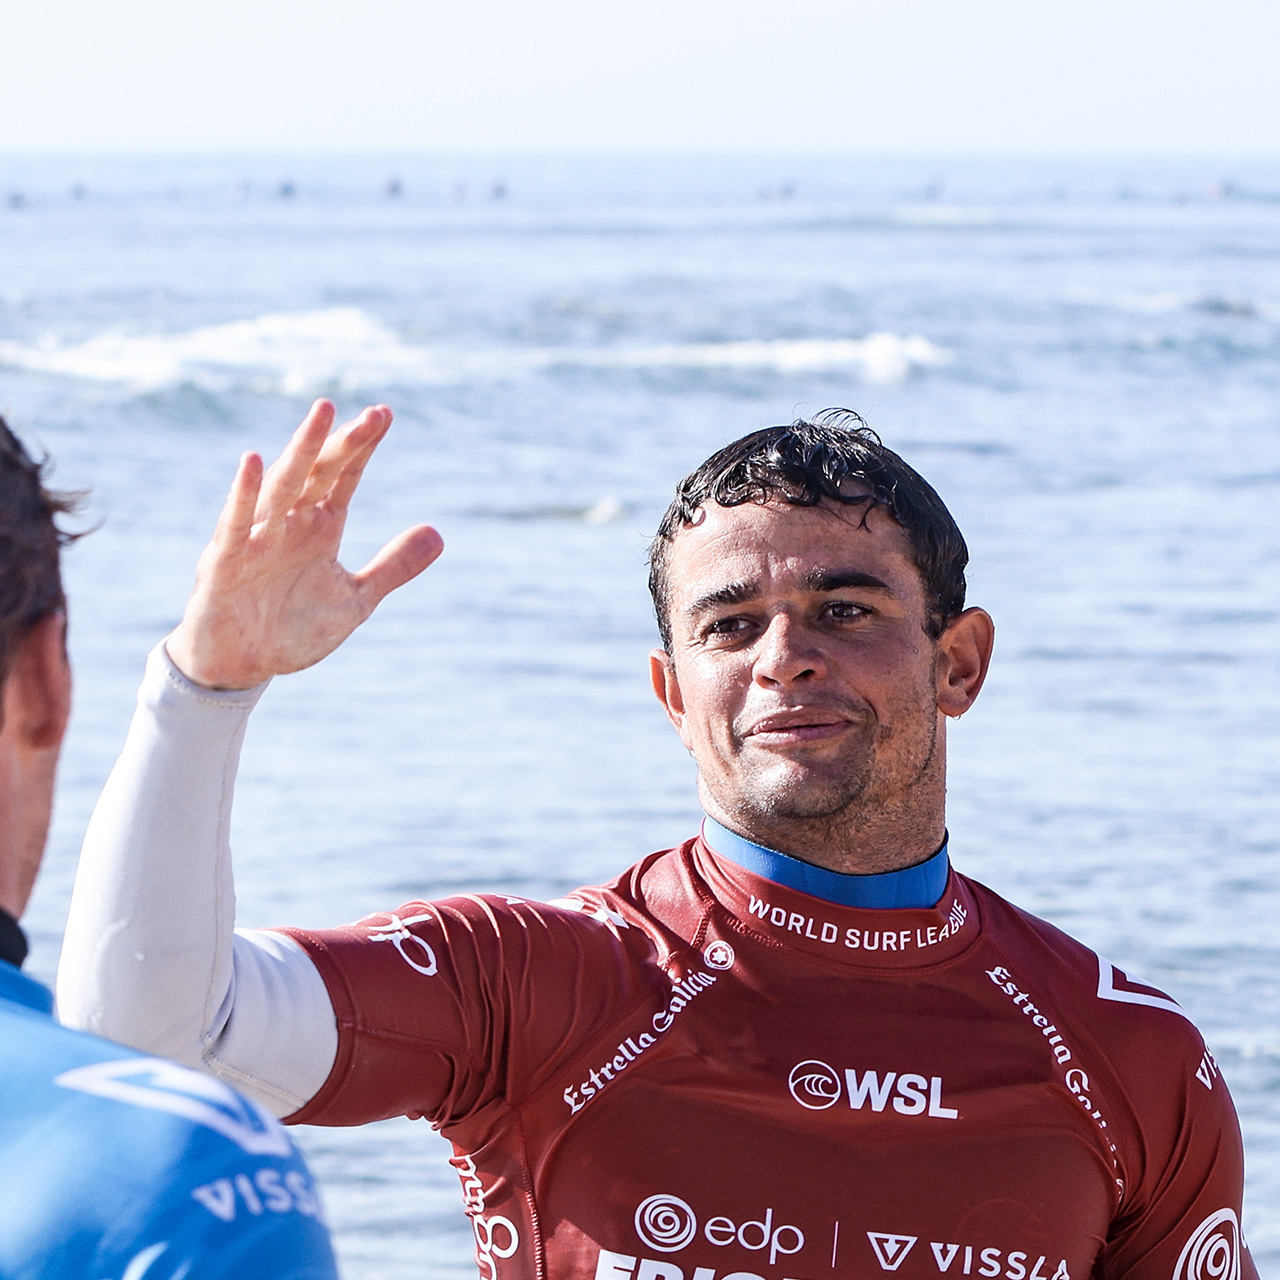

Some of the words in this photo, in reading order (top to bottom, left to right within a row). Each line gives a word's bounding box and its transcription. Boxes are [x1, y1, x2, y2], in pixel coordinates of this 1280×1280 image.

[747, 895, 839, 944] WORLD
[844, 928, 912, 951] SURF
[916, 898, 969, 949] LEAGUE
[562, 1033, 656, 1116] Estrella
[652, 967, 717, 1033] Galicia
[844, 1068, 958, 1119] WSL
[190, 1168, 322, 1222] VISS
[704, 1207, 805, 1265] edp
